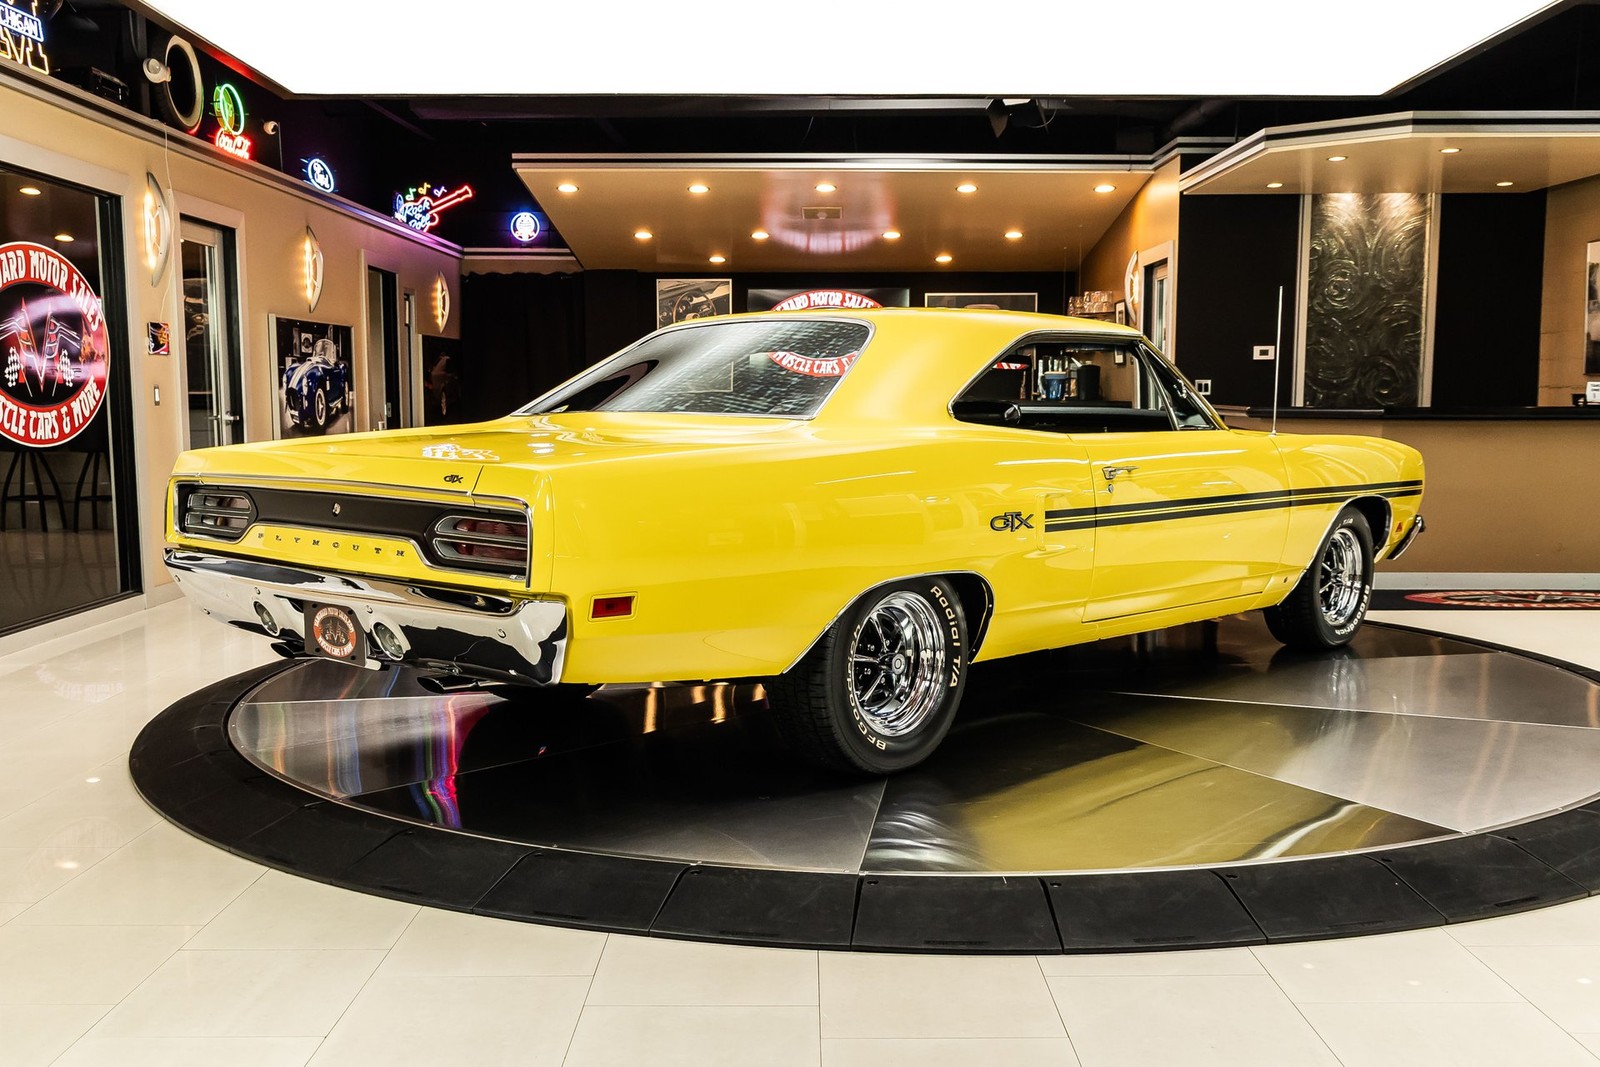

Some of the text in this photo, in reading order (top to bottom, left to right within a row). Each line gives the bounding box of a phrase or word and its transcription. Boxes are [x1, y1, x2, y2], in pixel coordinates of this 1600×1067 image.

[29, 250, 69, 292] MOTOR
[70, 273, 103, 331] SALES
[809, 291, 843, 306] MOTOR
[813, 359, 840, 375] CARS
[29, 410, 60, 440] CARS
[62, 410, 72, 434] &
[71, 375, 101, 427] MORE
[443, 474, 464, 484] GTX
[990, 511, 1035, 532] GTX
[257, 532, 406, 557] PLYMOUTH
[1335, 584, 1370, 635] BFGoodrich
[930, 585, 962, 688] Radial T/A
